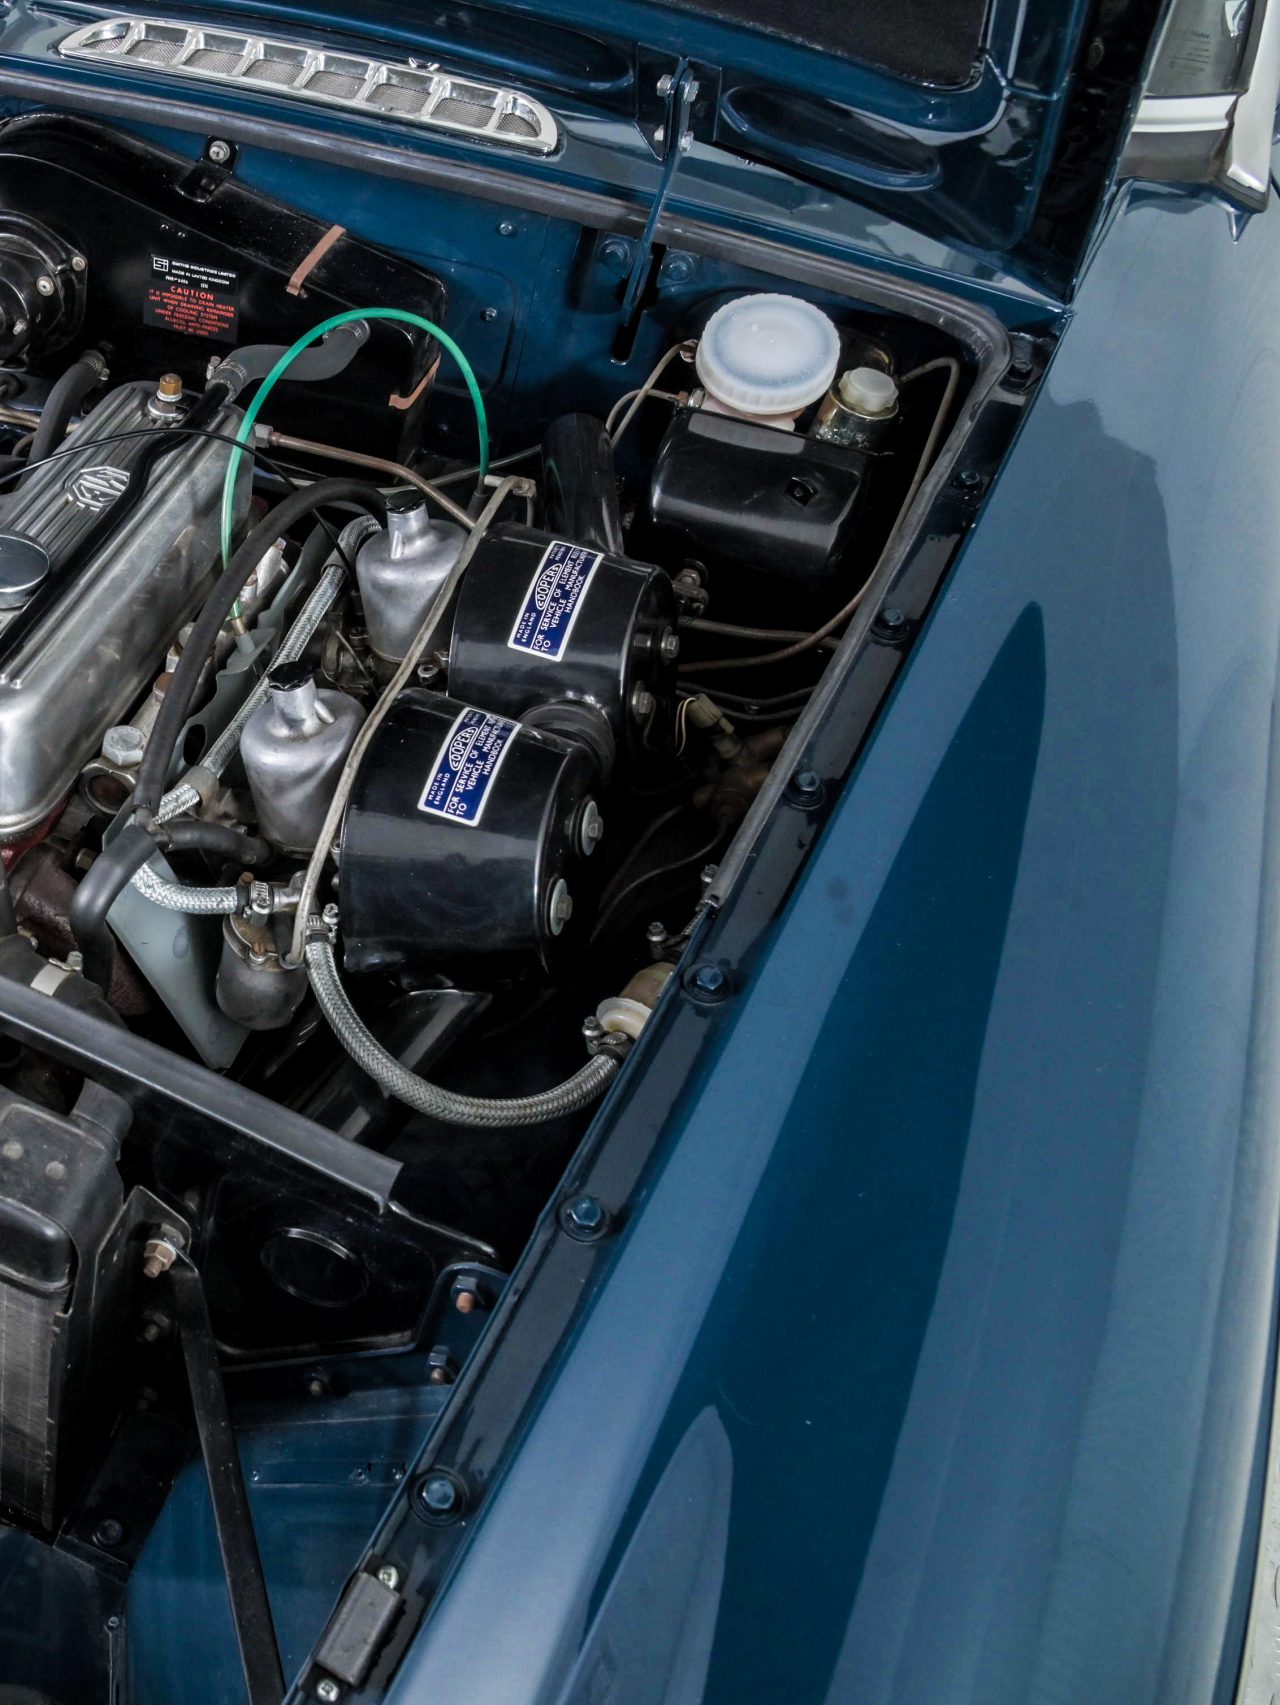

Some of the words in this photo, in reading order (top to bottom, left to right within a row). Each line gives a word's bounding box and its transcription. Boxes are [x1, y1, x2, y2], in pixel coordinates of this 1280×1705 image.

[190, 263, 218, 274] INDUSTRIES
[218, 269, 236, 278] LIMITED
[192, 273, 208, 281] UNITED
[170, 286, 214, 300] CAUTION
[180, 302, 204, 311] DRAINING
[216, 303, 234, 311] HEATER
[174, 312, 196, 321] FREEZING
[176, 307, 198, 316] COOLING
[537, 565, 559, 607] COOPERS
[534, 634, 545, 650] FOR
[541, 602, 557, 630] SERVICE
[554, 589, 562, 598] OF
[559, 560, 574, 585] ELEMENT
[516, 621, 526, 638] MADE
[524, 612, 530, 621] IN
[522, 612, 536, 643] ENGLAND
[541, 640, 551, 652] TO
[550, 599, 567, 628] VEHICLE
[451, 729, 475, 767] COOPERS
[482, 739, 502, 776] HANDBOOK
[447, 796, 460, 814] FOR
[455, 763, 474, 792] SERVICE
[469, 750, 479, 759] OF
[475, 726, 492, 746] ELEMENT
[428, 784, 438, 800] MADE
[436, 773, 443, 781] IN
[434, 773, 450, 805] ENGLAND
[456, 802, 467, 816] TO
[465, 760, 484, 790] VEHICLE
